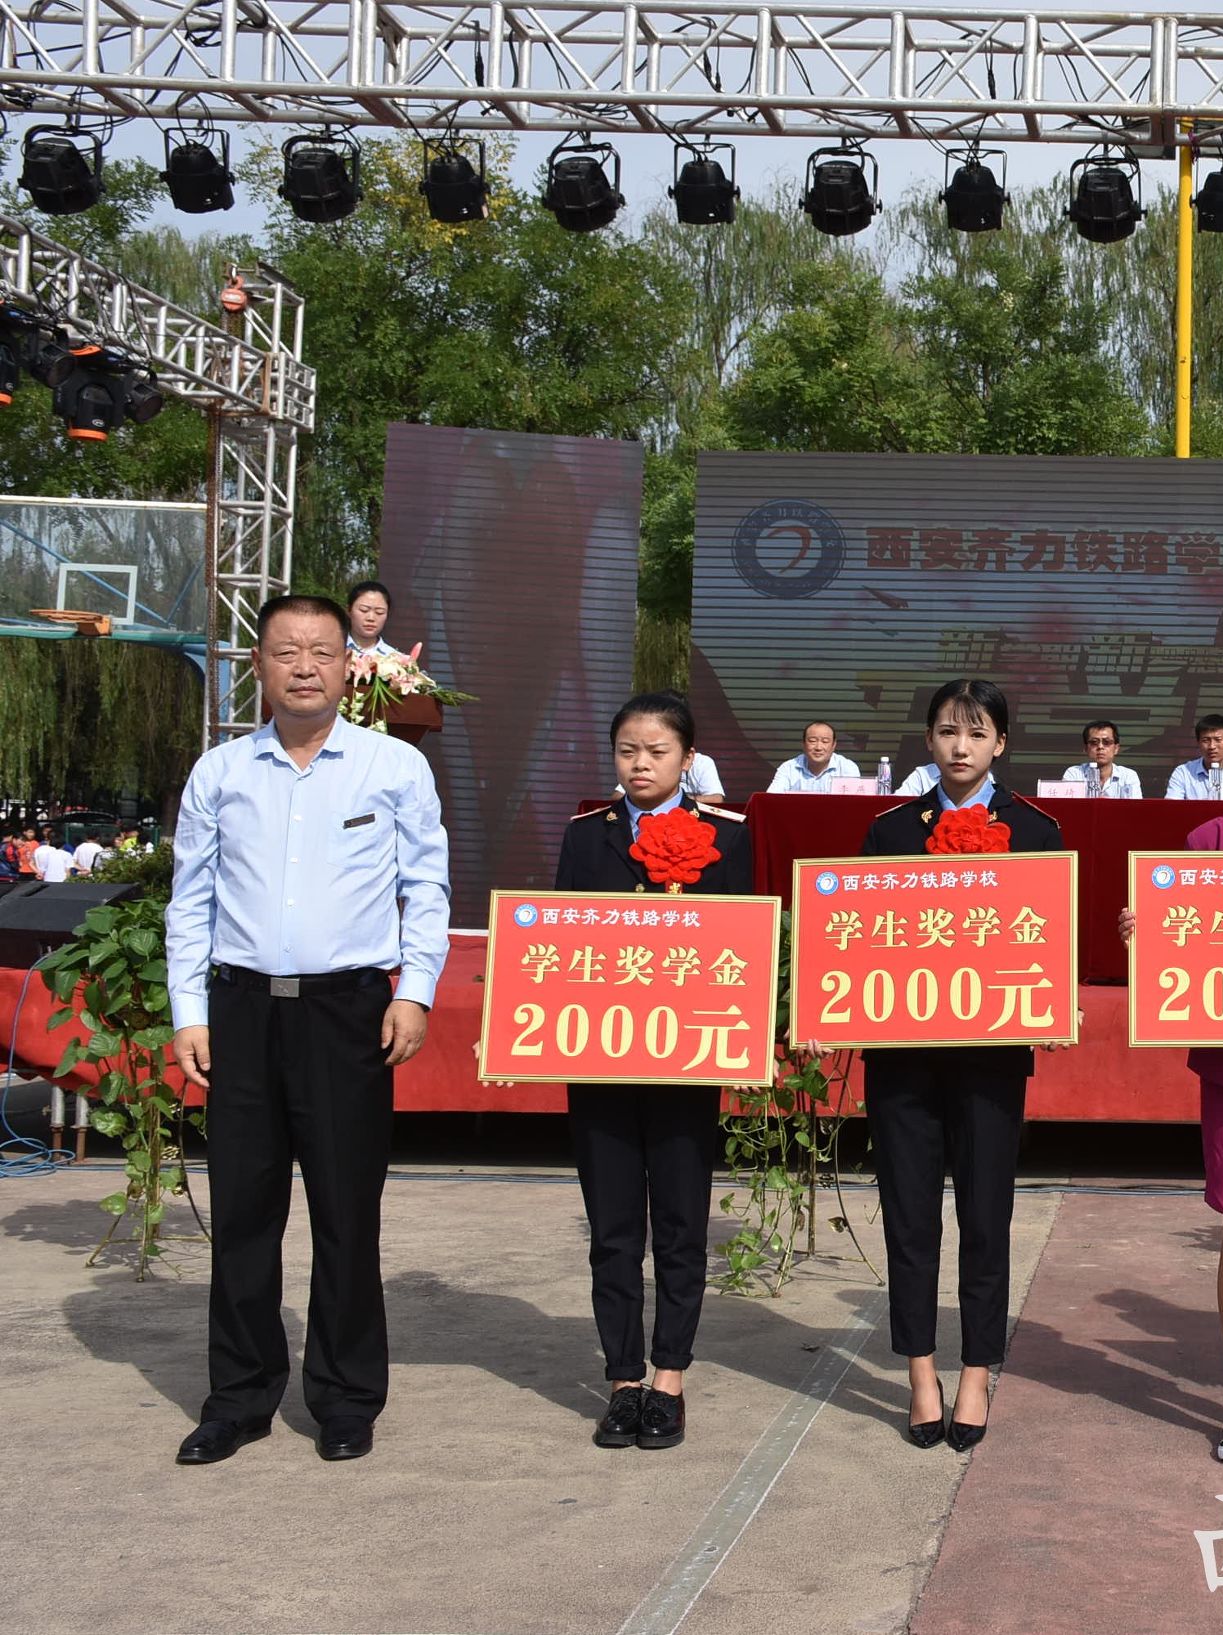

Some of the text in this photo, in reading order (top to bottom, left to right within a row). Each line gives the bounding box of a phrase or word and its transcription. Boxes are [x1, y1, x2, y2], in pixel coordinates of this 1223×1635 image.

[842, 870, 998, 892] 西安齐力铁路学校
[542, 908, 700, 928] 西安齐力铁路学校
[825, 906, 1048, 951] 学生奖学金
[520, 943, 749, 987] 学生奖学金
[820, 962, 1055, 1032] 2000元
[511, 1003, 750, 1071] 2000元
